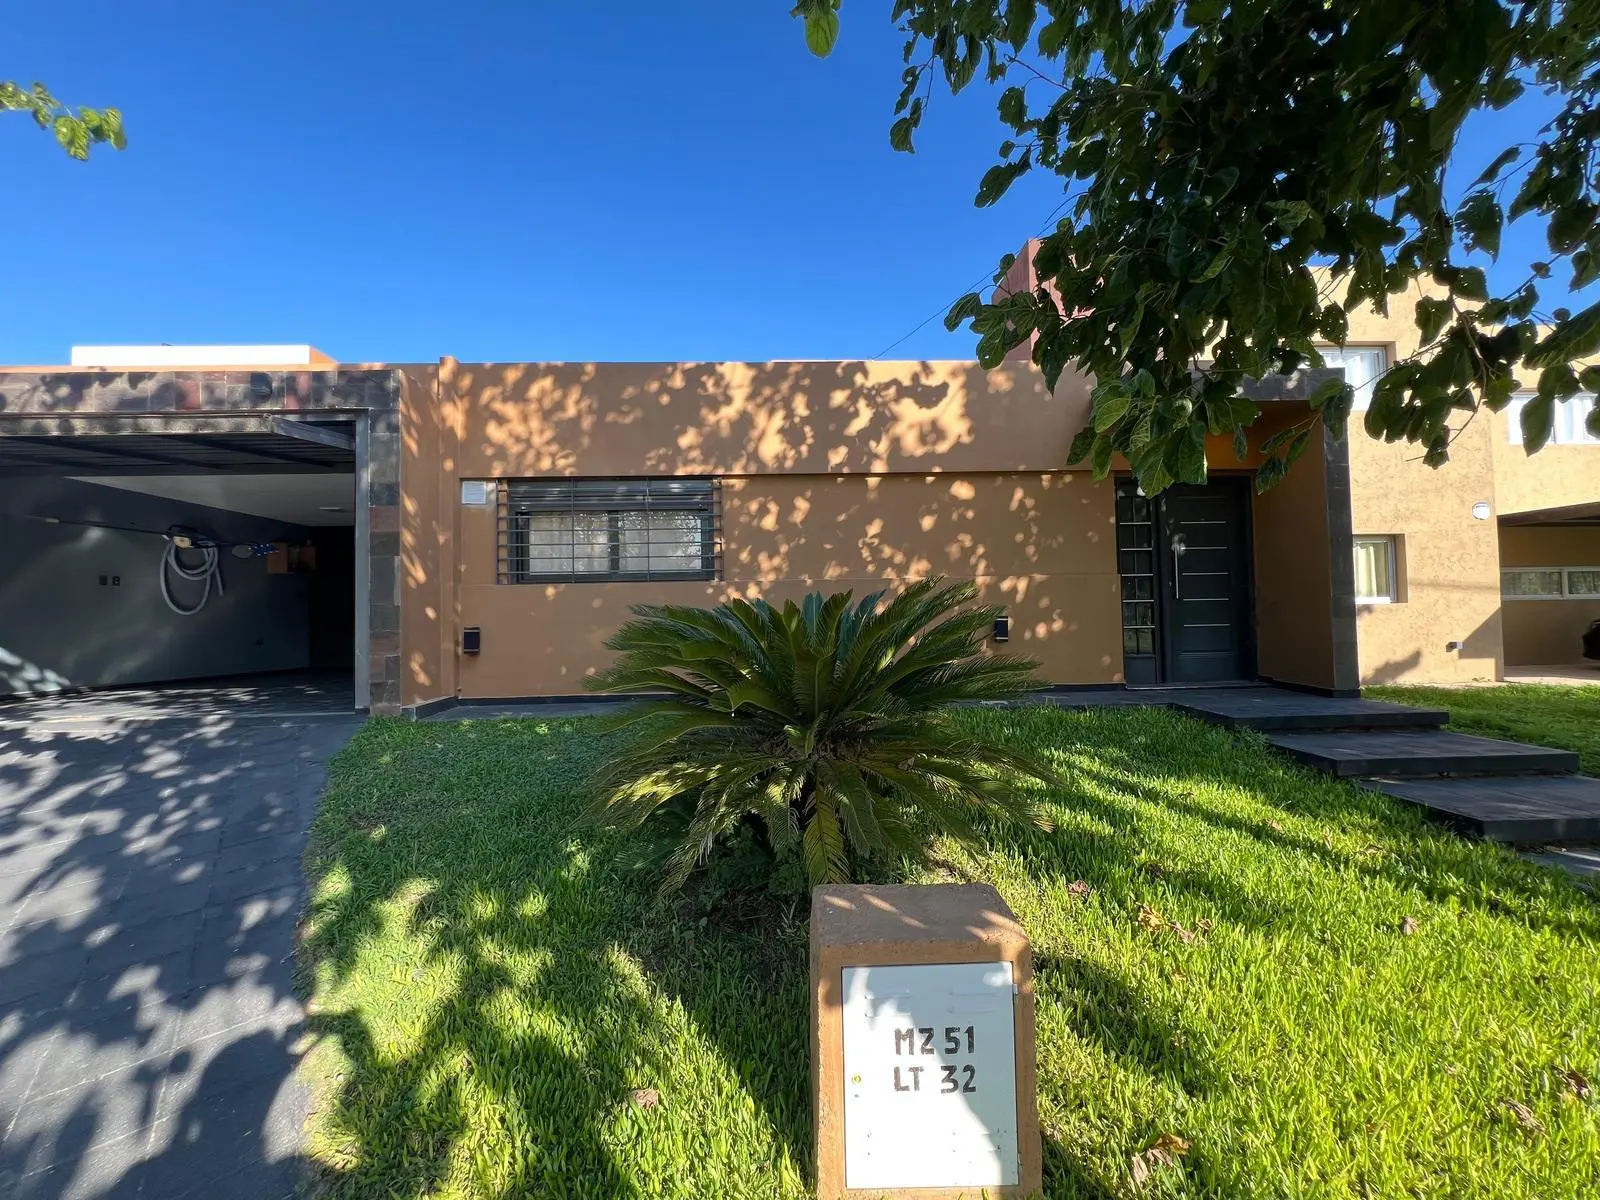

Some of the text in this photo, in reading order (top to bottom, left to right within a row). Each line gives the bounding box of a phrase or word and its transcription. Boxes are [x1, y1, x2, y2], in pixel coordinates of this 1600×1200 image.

[894, 1025, 975, 1055] MZ 51
[893, 1064, 977, 1094] LT 32
